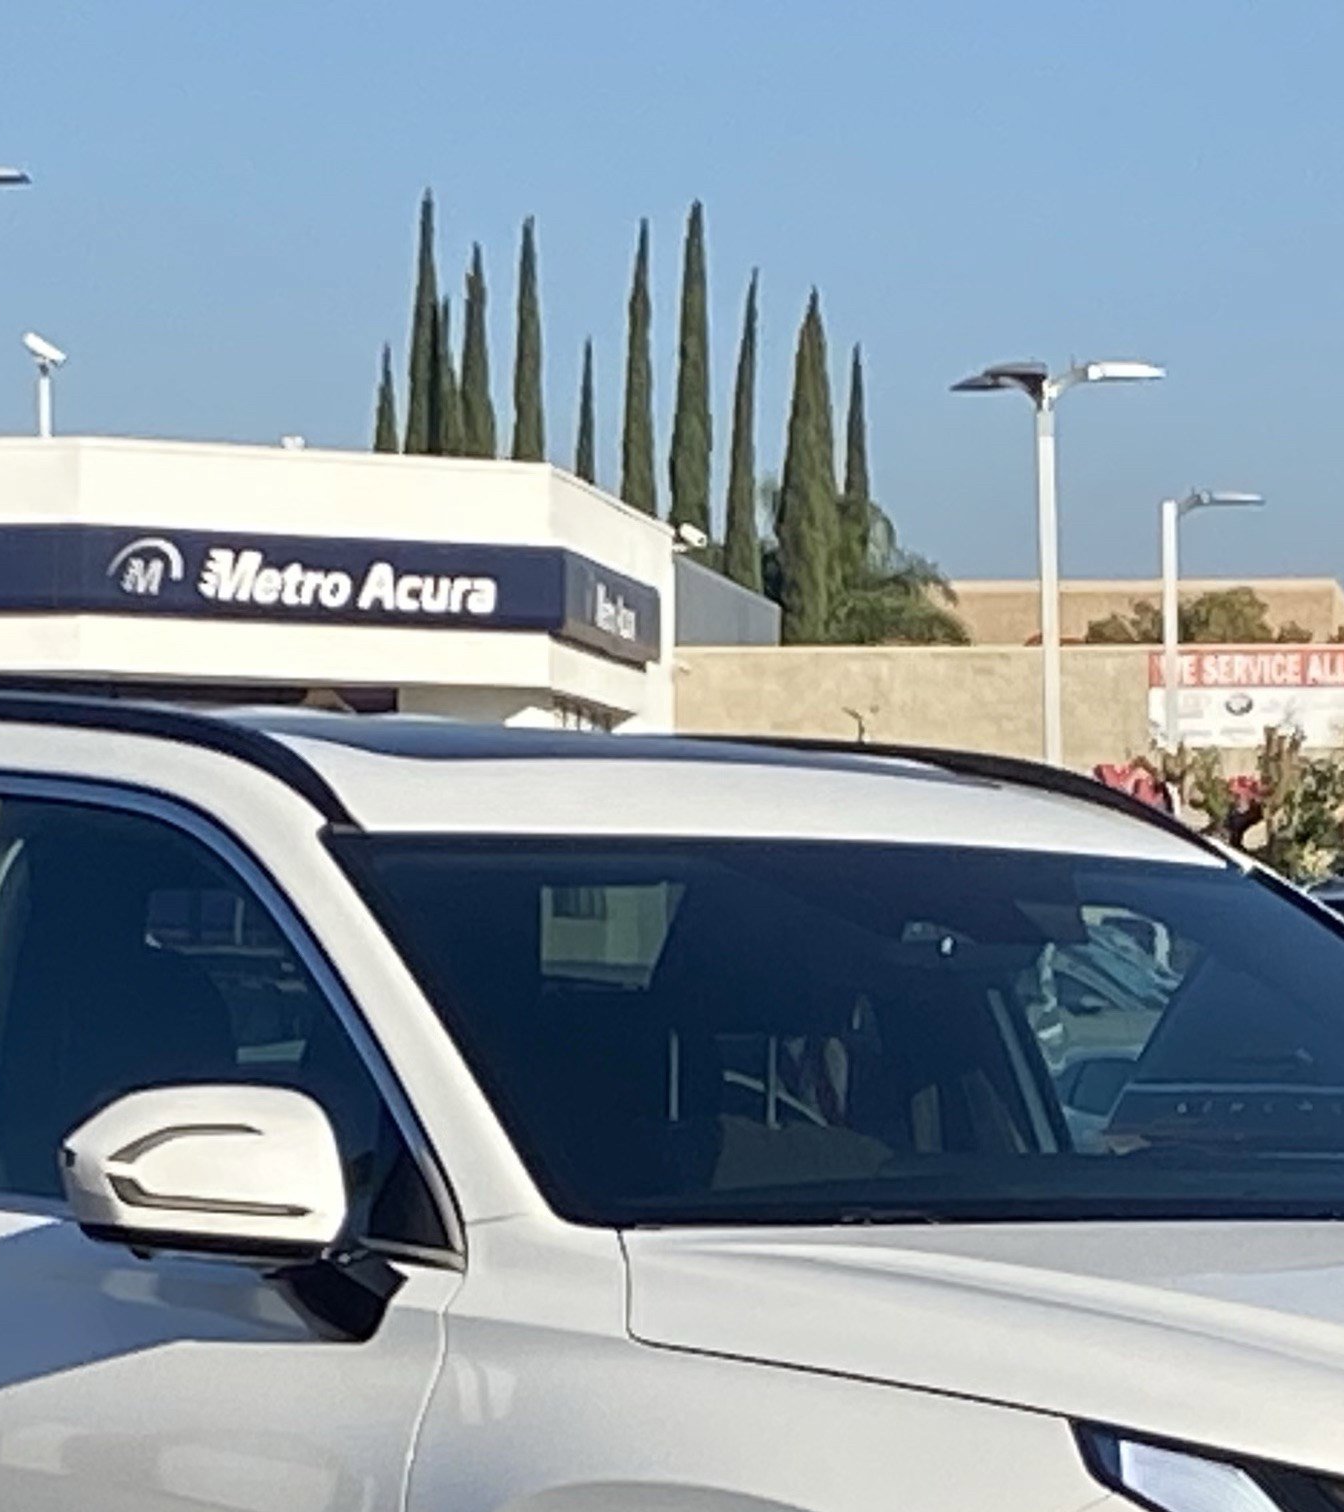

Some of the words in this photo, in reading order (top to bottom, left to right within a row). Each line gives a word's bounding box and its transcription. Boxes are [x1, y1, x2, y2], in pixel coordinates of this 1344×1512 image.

[196, 547, 353, 608] Metro
[358, 561, 498, 615] Acura
[1201, 652, 1301, 685] SERVICE
